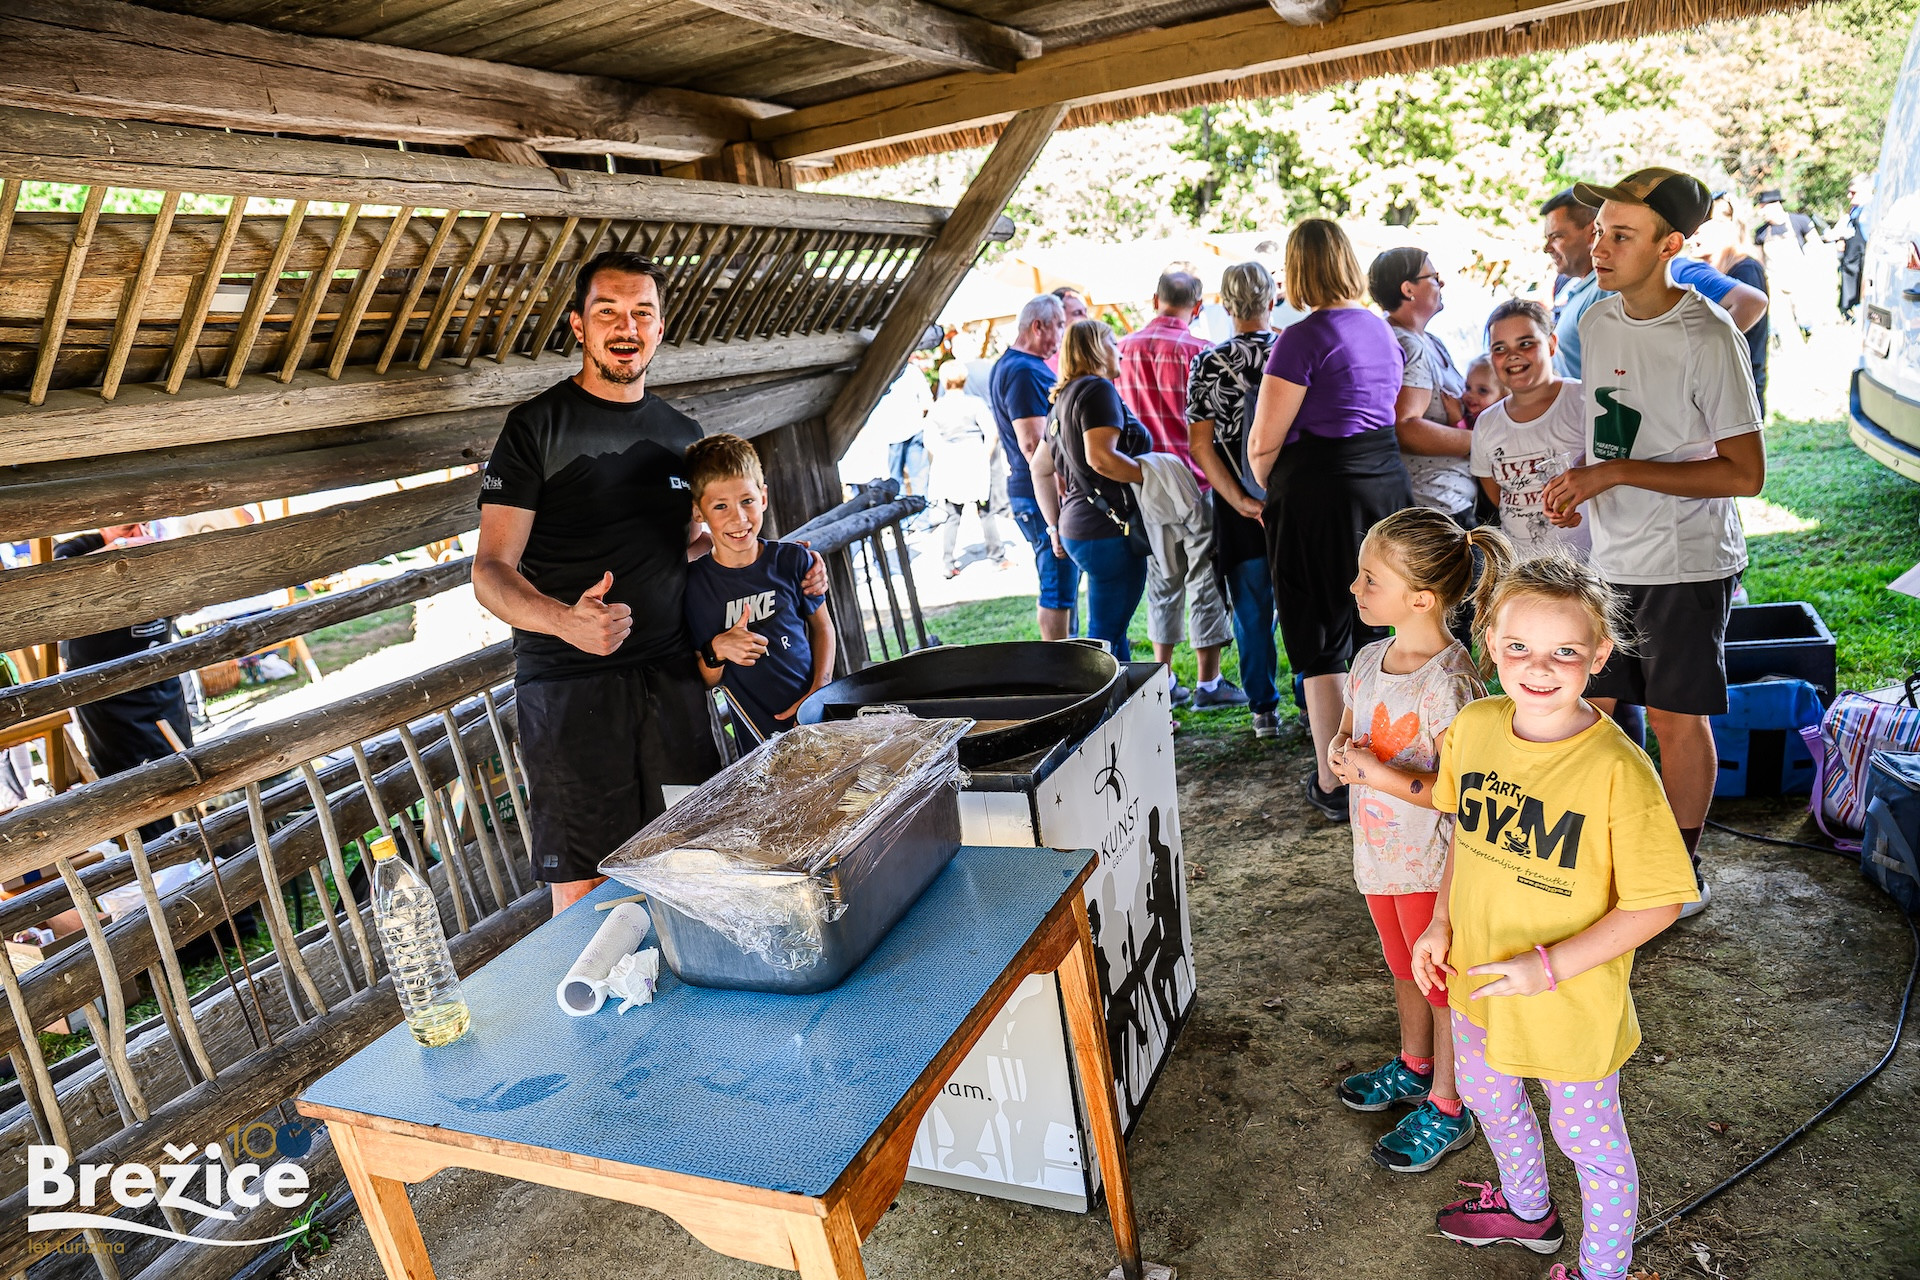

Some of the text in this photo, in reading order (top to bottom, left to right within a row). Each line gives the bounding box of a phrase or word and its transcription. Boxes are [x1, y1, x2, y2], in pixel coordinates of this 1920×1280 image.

[1485, 770, 1526, 807] PARTY
[1101, 796, 1139, 866] KUNST
[1457, 771, 1586, 870] GYM
[1112, 835, 1135, 869] GOSTILNA
